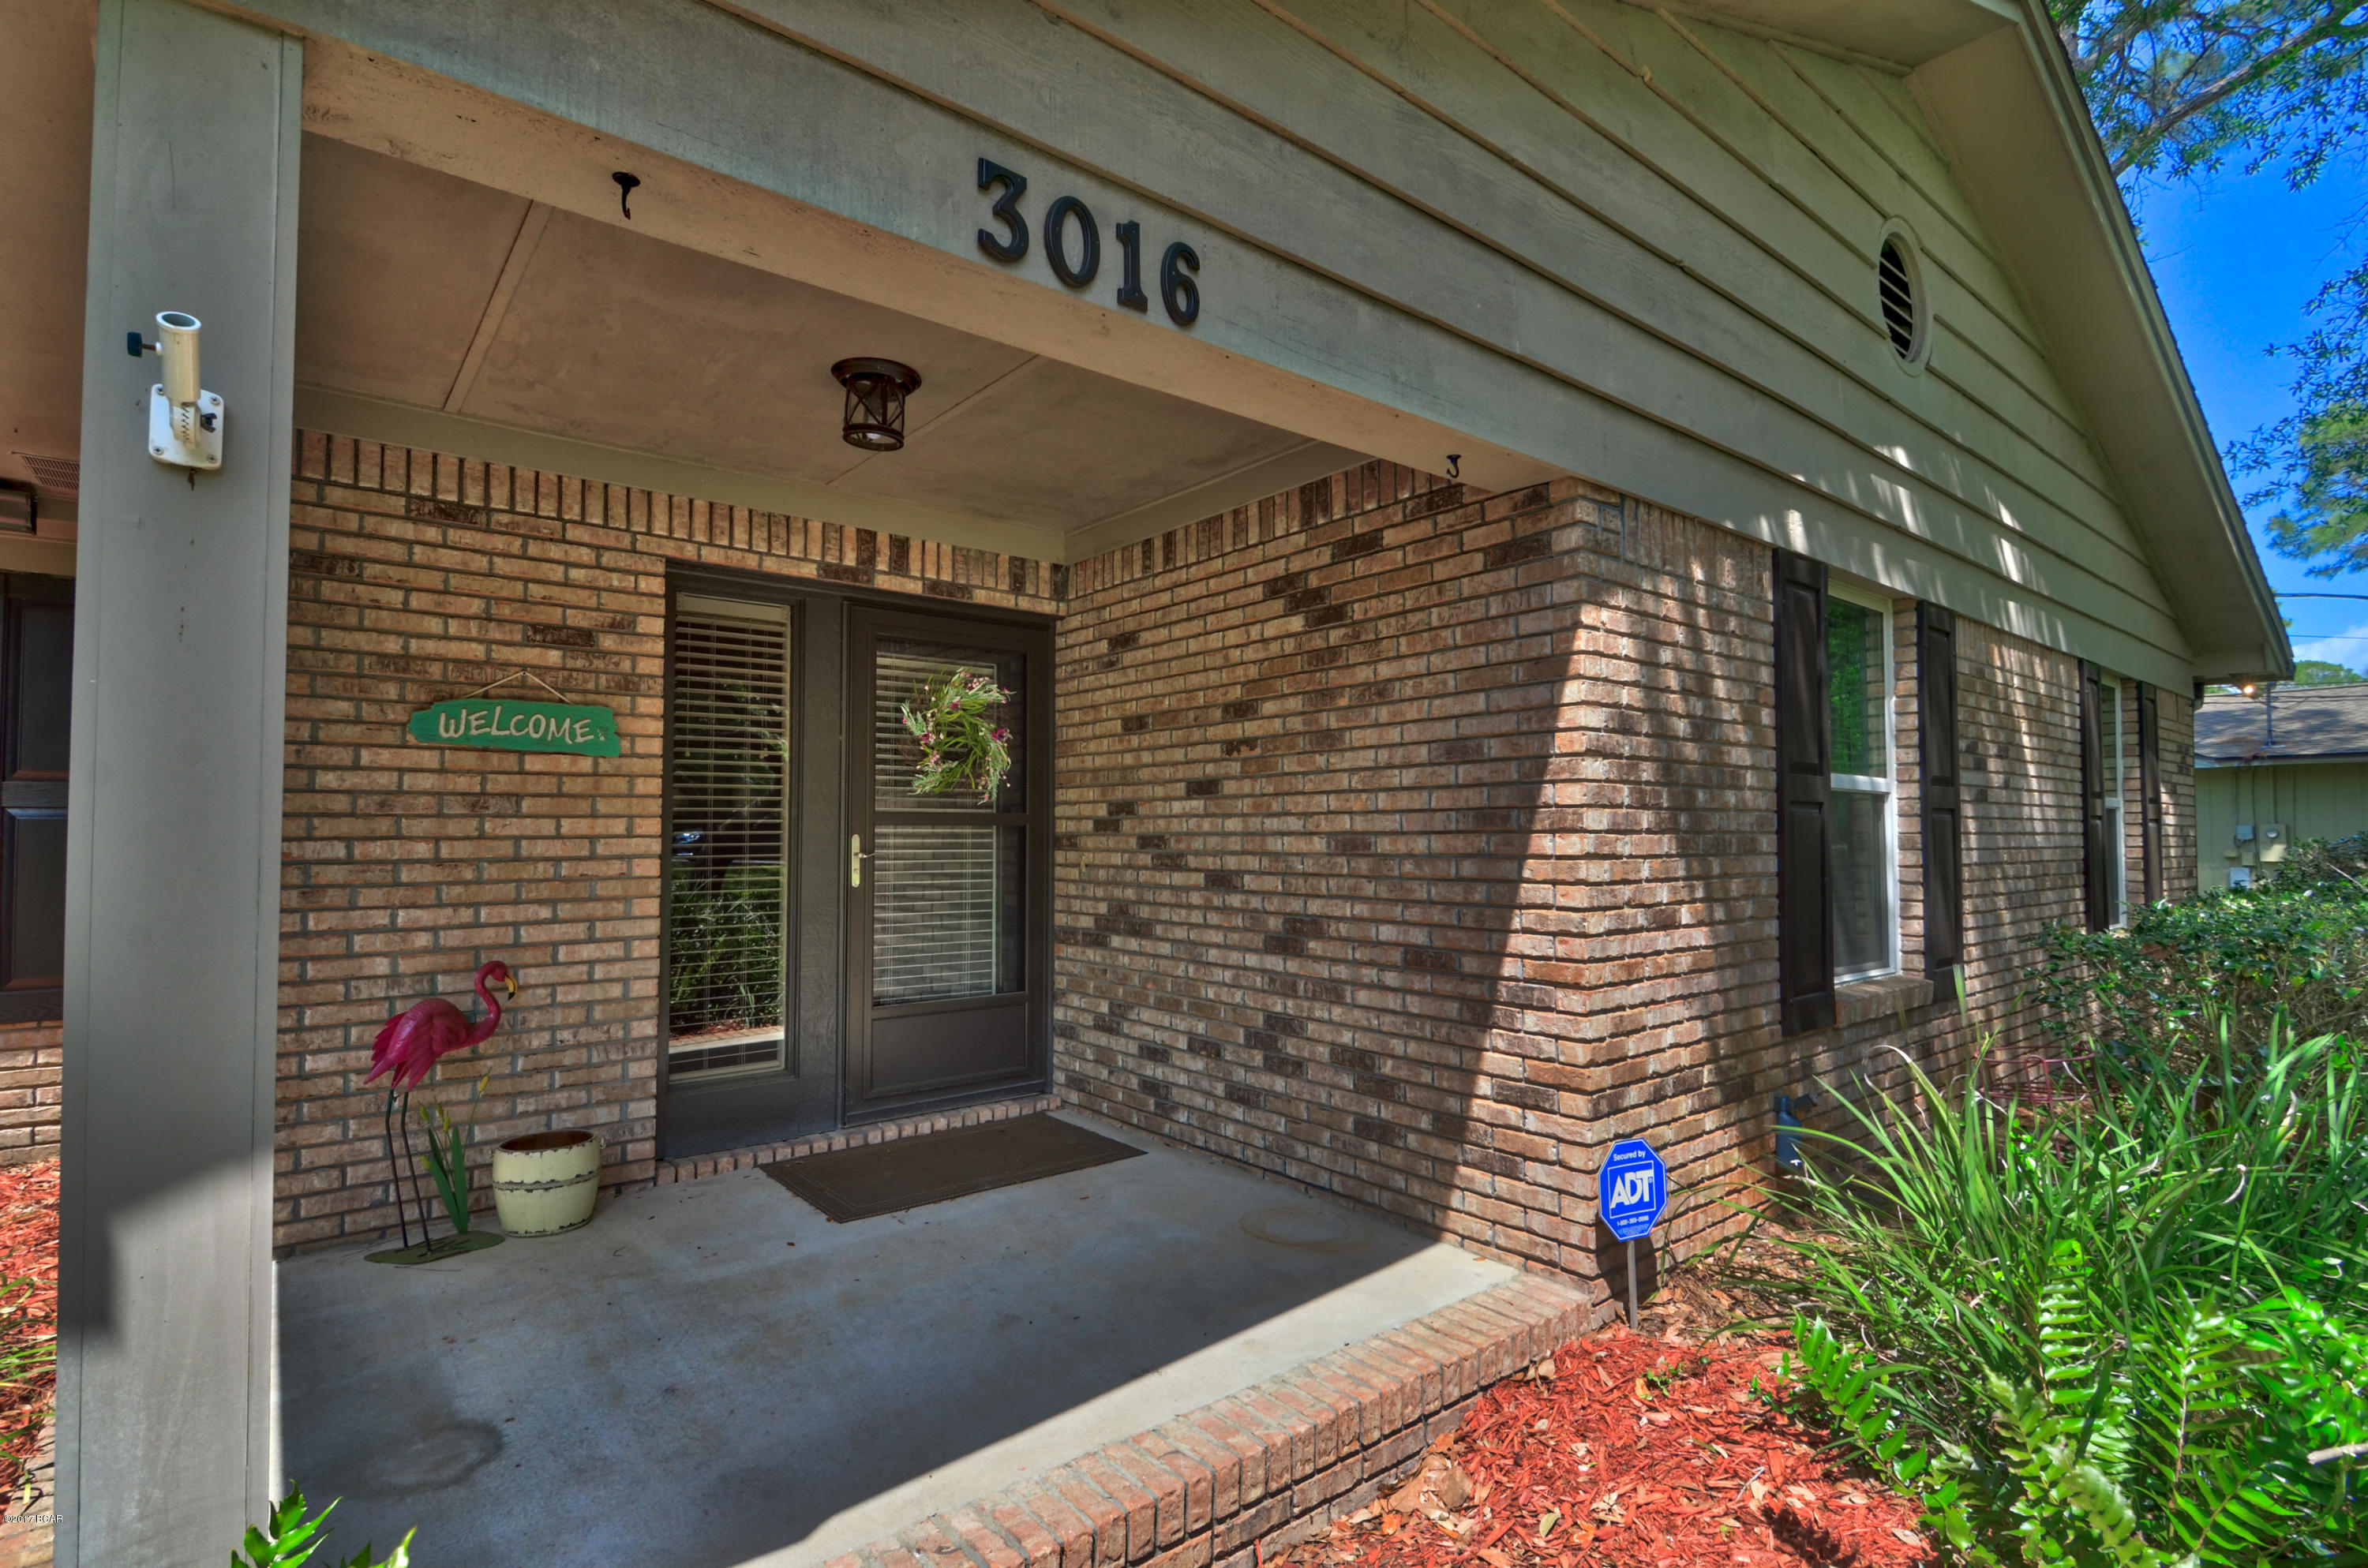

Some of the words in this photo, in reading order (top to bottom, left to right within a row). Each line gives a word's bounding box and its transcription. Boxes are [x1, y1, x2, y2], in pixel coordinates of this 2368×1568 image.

[977, 156, 1201, 327] 3016
[1613, 1151, 1637, 1161] Secured
[1638, 1150, 1646, 1158] by
[1611, 1169, 1654, 1208] ADT
